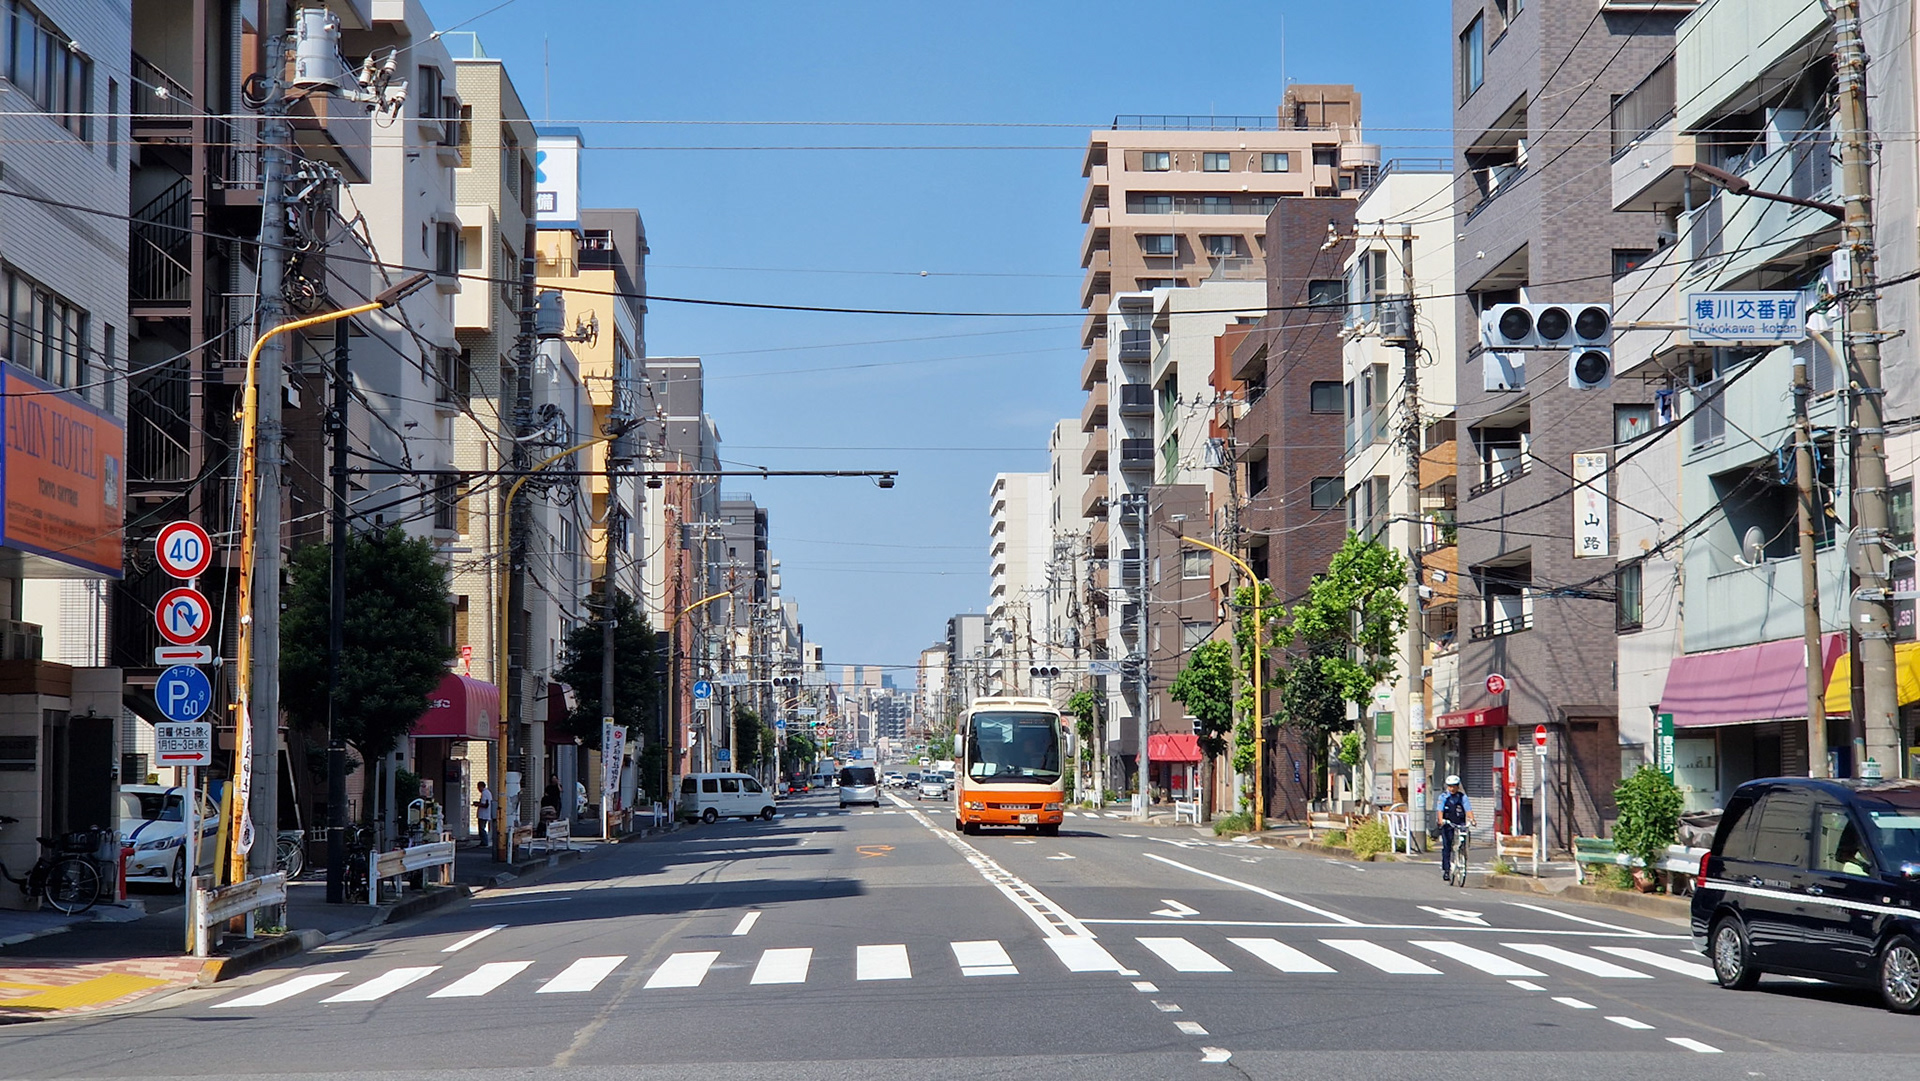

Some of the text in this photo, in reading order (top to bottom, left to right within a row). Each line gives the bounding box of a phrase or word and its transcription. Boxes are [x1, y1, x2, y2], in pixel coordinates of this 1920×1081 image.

[1695, 299, 1797, 320] 横川交番前
[1696, 322, 1797, 334] Yokokawa koban
[51, 410, 97, 480] HOTEL
[1584, 513, 1601, 550] 山路
[170, 538, 199, 563] 40
[171, 667, 196, 678] 9-19
[168, 680, 190, 716] P
[182, 699, 198, 716] 60
